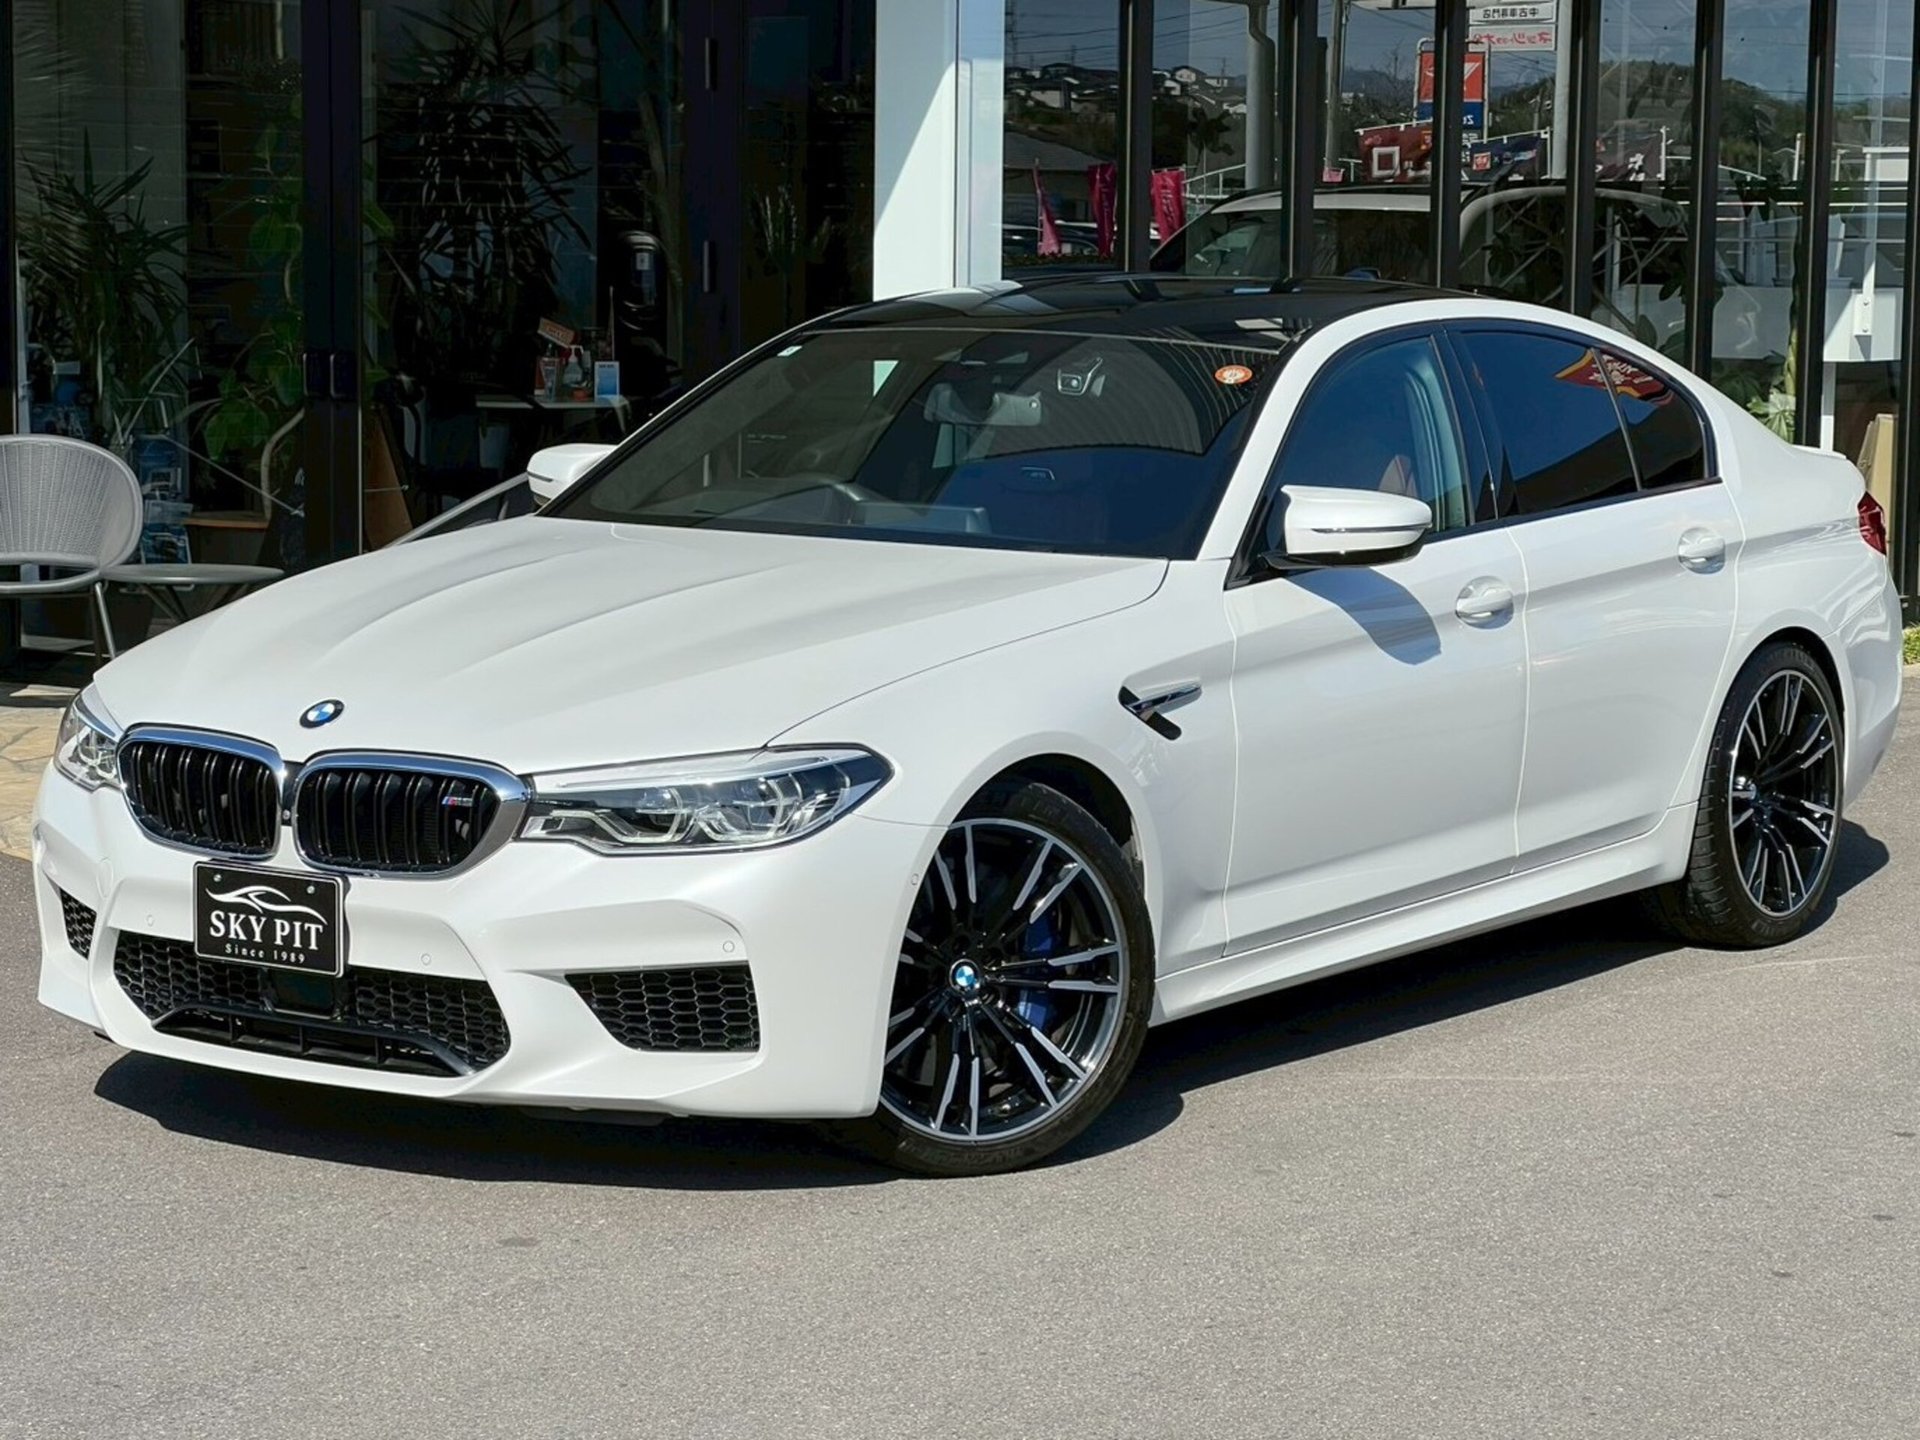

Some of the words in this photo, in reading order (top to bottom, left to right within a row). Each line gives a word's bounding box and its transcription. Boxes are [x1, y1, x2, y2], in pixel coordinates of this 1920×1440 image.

[209, 910, 267, 943] SKY
[273, 918, 324, 951] PIT
[225, 943, 265, 959] Since
[273, 950, 306, 964] 1989
